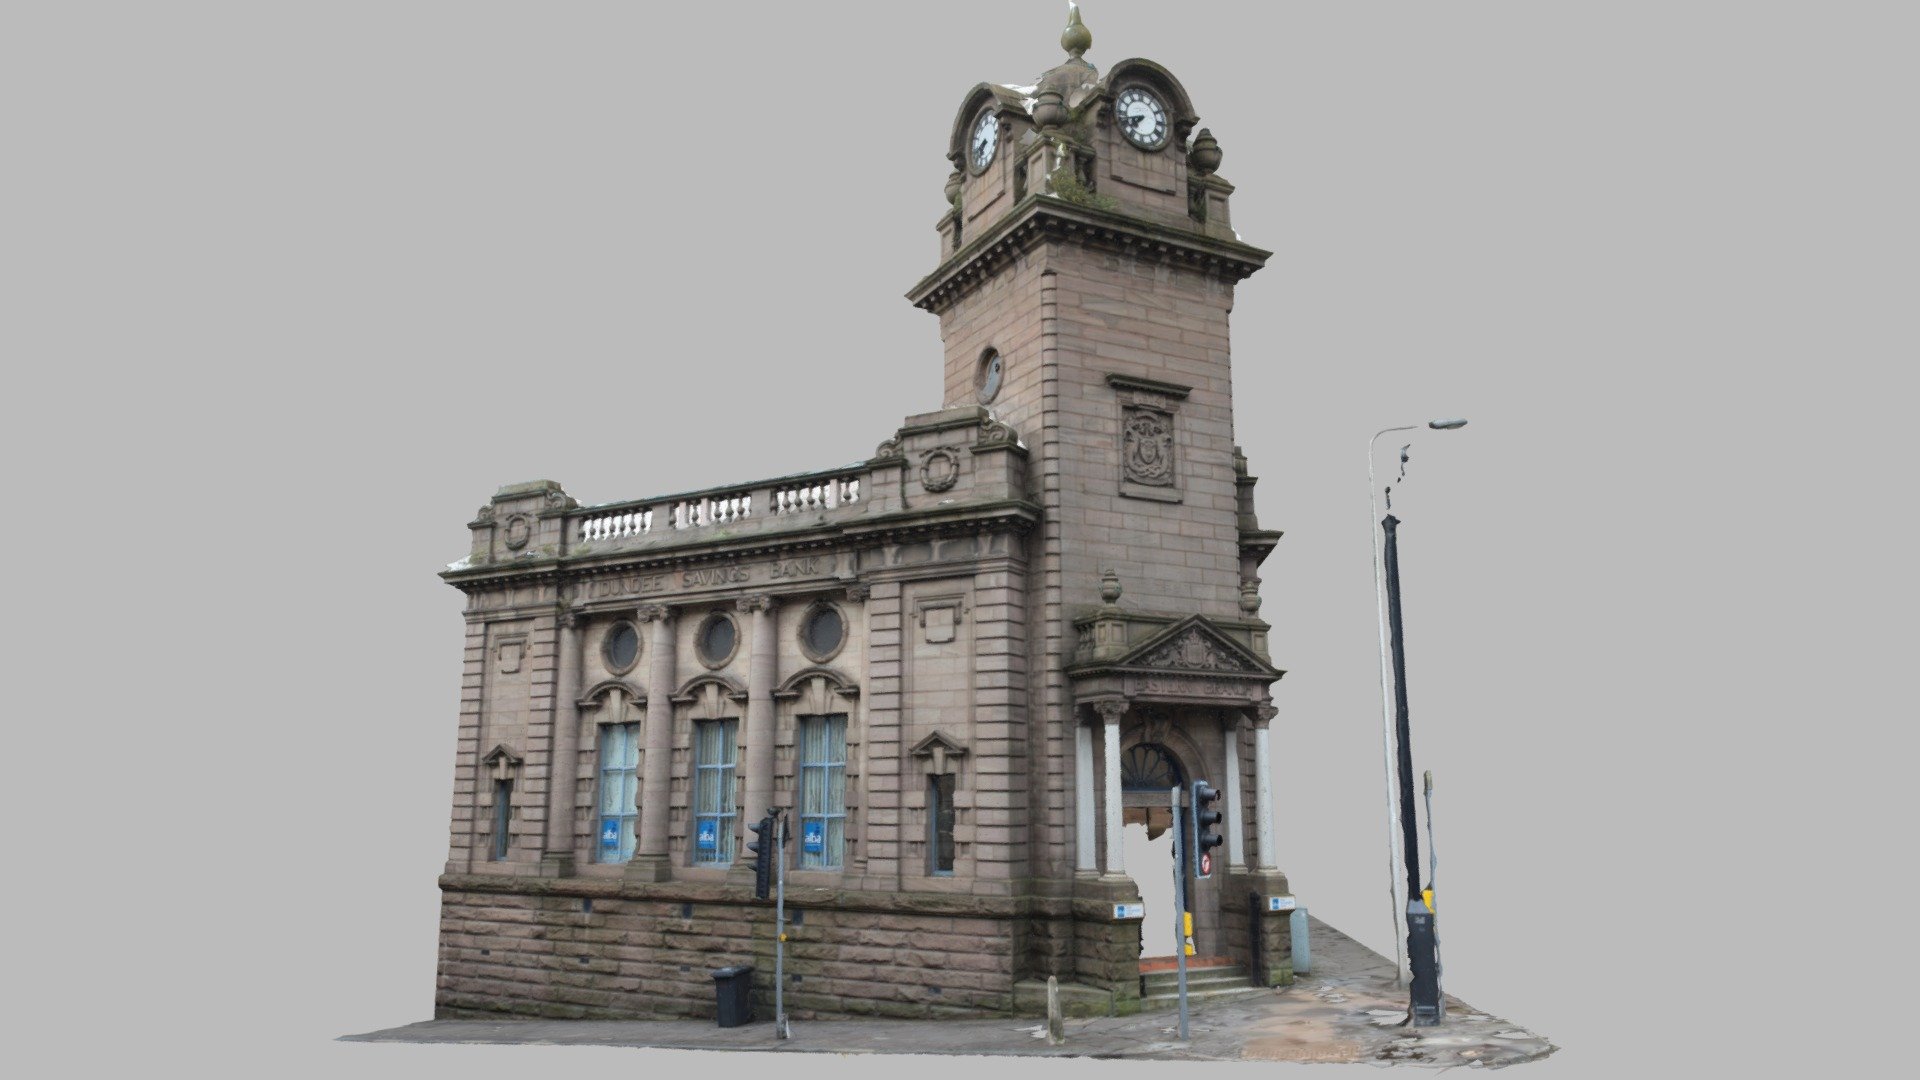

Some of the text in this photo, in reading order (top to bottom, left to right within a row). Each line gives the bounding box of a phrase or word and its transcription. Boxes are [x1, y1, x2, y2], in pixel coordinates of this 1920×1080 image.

[600, 557, 819, 596] DUNDEE SAVINGS BANK
